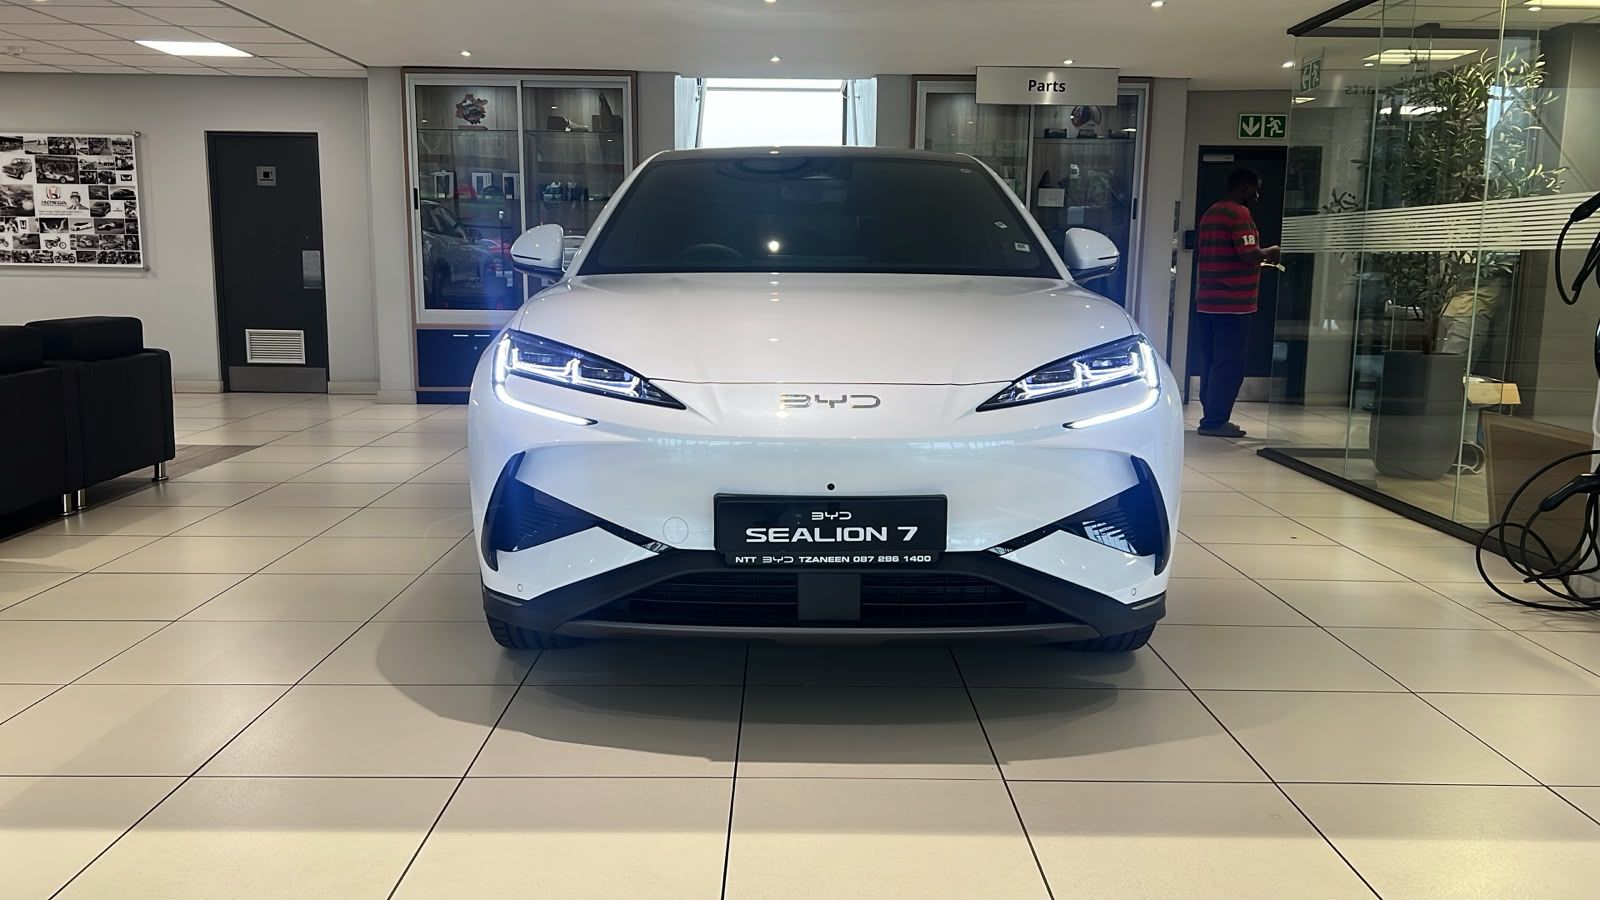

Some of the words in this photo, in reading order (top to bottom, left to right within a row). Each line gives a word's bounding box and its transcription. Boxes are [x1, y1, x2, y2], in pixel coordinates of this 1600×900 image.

[1028, 79, 1066, 94] Parts
[1242, 234, 1256, 246] 18
[780, 394, 881, 409] BYD
[811, 511, 852, 521] BYD
[745, 526, 888, 543] SEALION
[897, 526, 919, 542] 7
[735, 555, 757, 564] NTT
[762, 555, 794, 564] BYD
[798, 555, 850, 564] TZANEEN
[852, 555, 875, 563] 087
[903, 555, 932, 563] 1400
